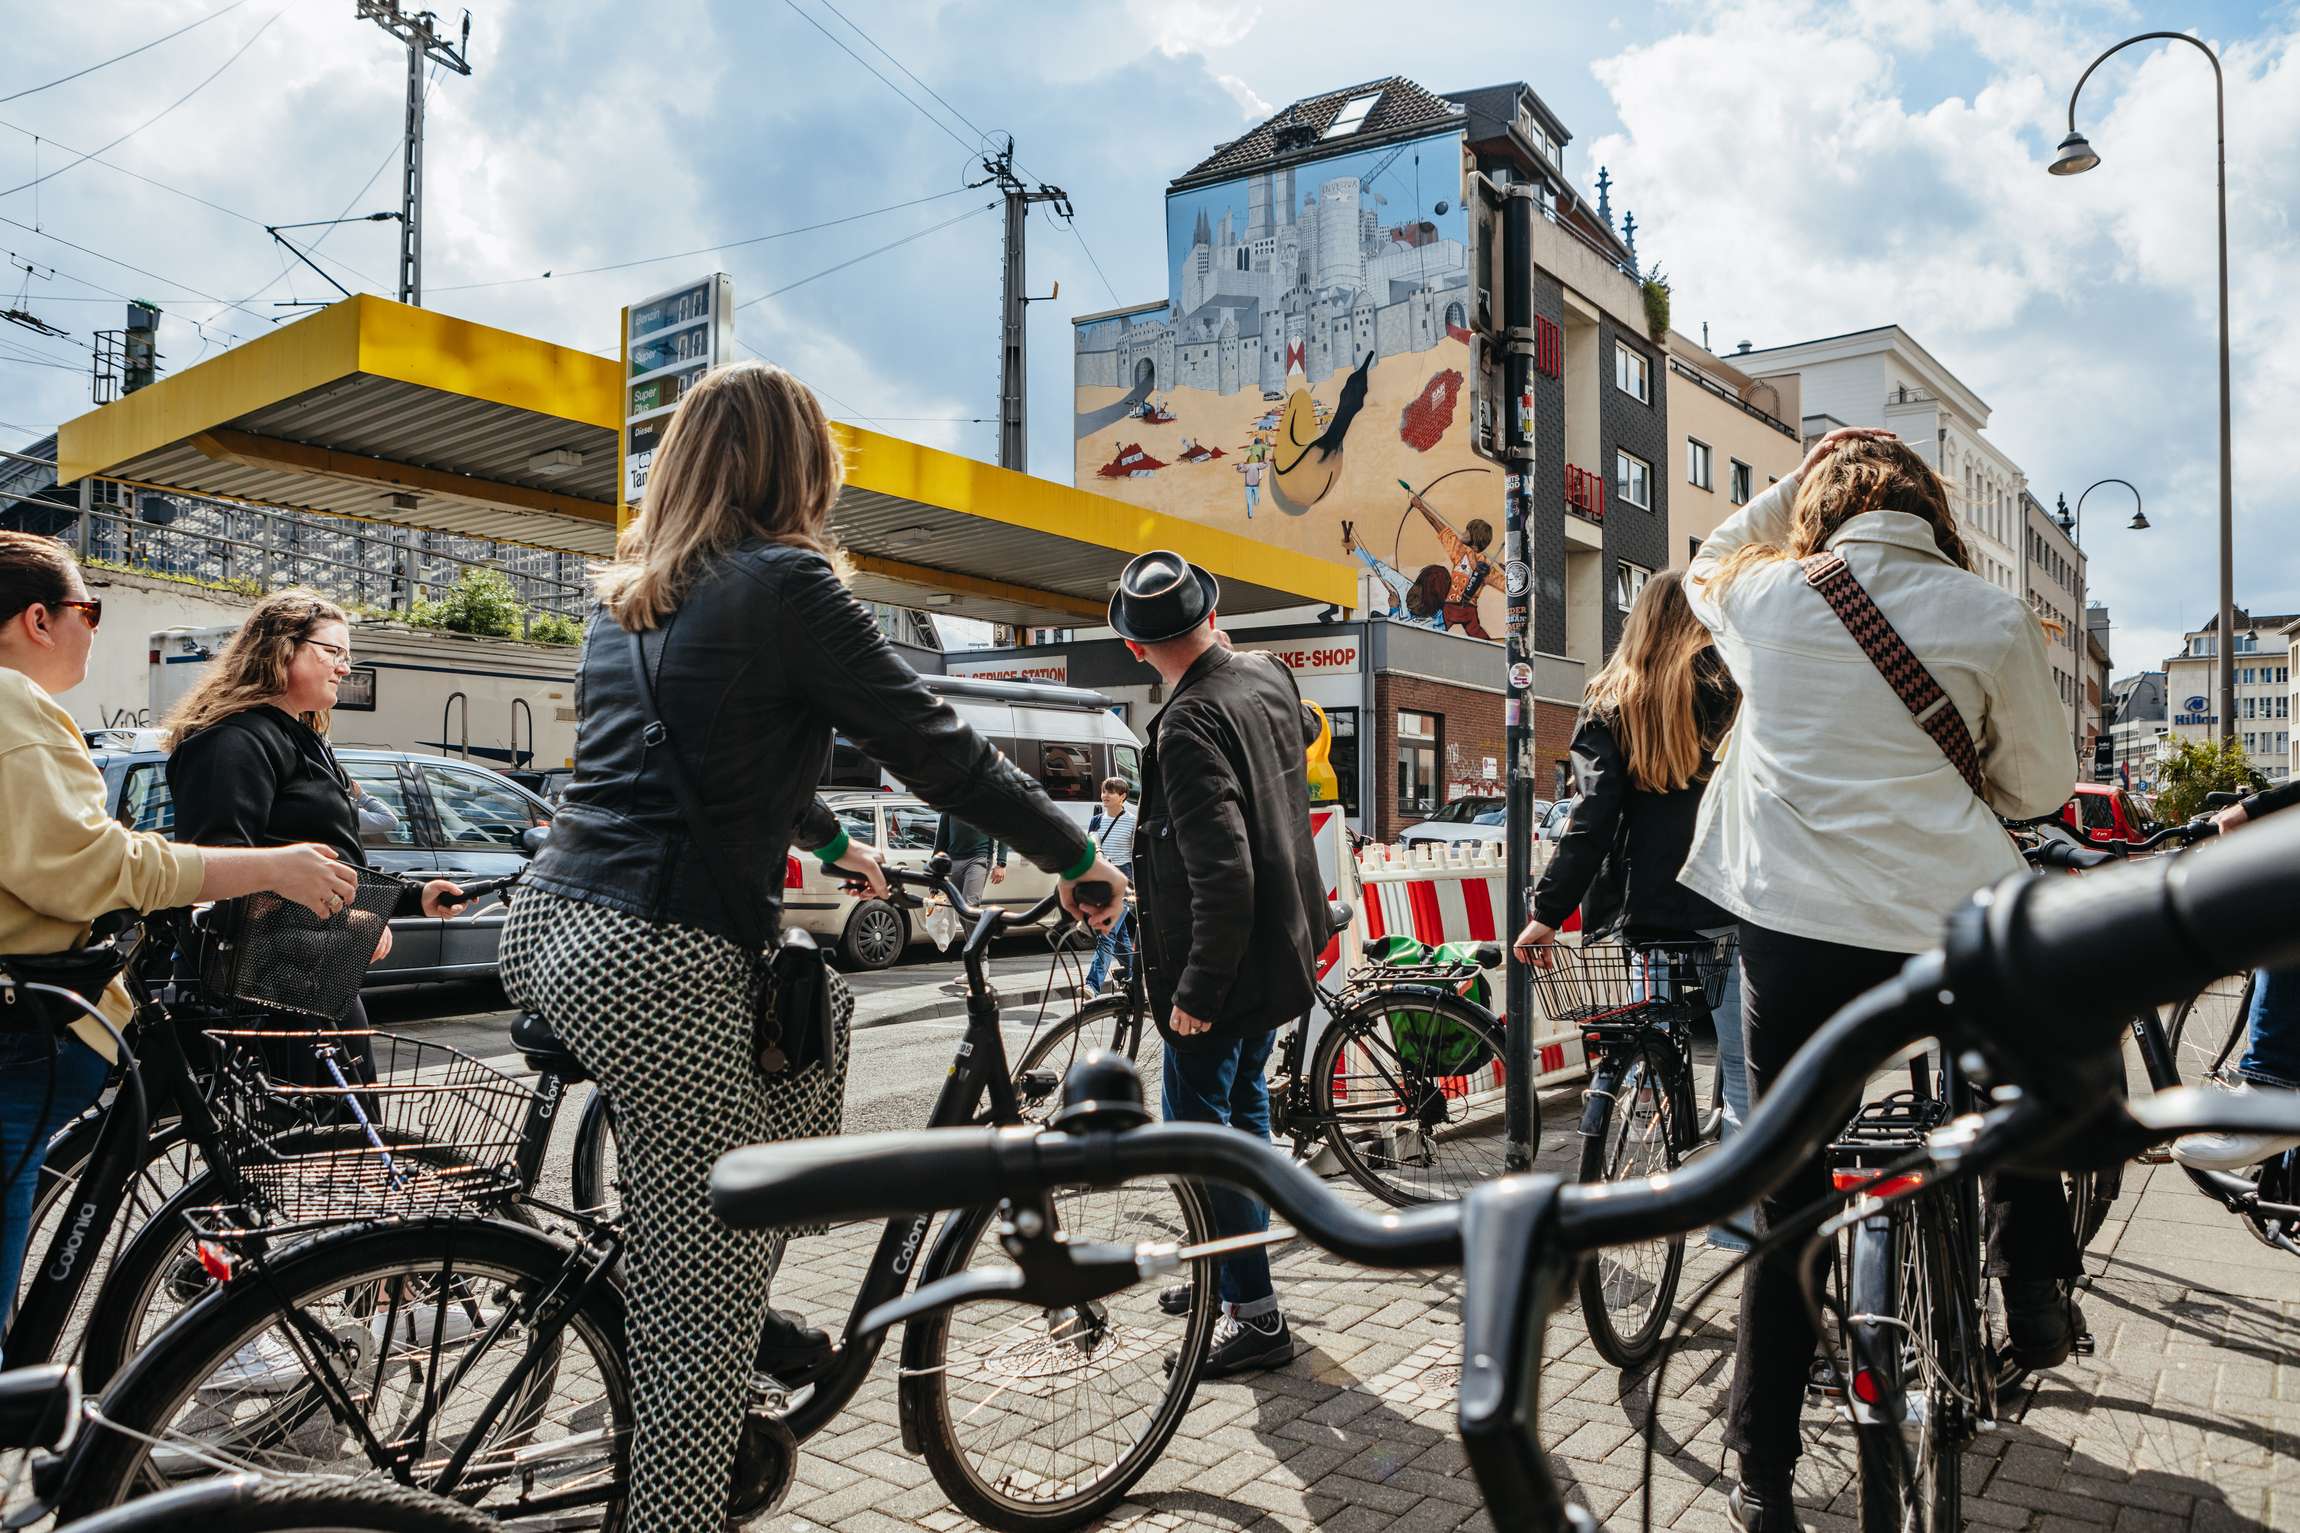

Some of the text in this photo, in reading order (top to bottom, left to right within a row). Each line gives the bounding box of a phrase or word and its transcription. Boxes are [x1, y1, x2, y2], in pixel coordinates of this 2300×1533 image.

[635, 309, 661, 326] Benzin
[634, 349, 657, 365] Super
[633, 386, 657, 403] Super
[633, 402, 650, 417] Plus
[634, 423, 653, 437] Diesel
[1021, 666, 1066, 682] STATION
[2174, 714, 2219, 726] Hilton
[50, 1202, 97, 1281] Colonia
